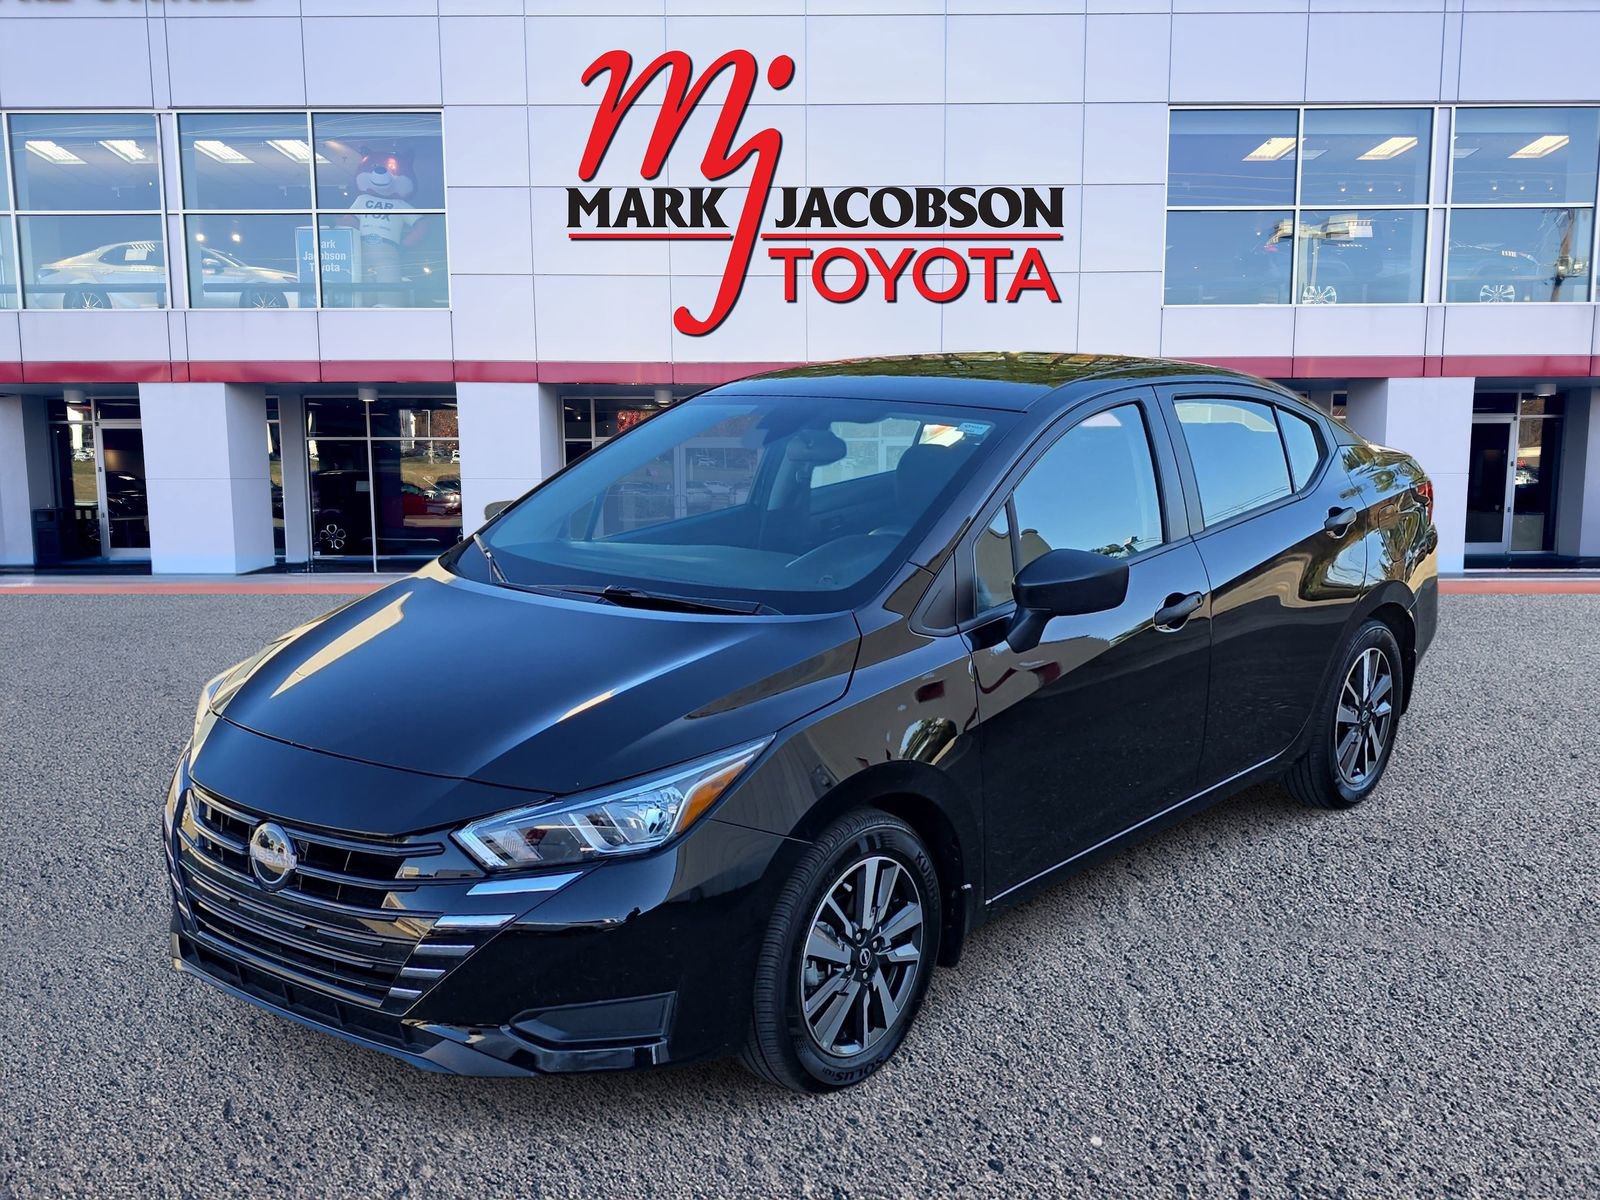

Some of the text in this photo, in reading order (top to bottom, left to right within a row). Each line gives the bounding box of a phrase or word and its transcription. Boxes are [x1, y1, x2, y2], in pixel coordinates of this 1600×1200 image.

[365, 199, 394, 209] CAR
[566, 186, 1065, 229] MARK JACOBSON
[309, 262, 340, 273] Tyota
[767, 247, 1062, 304] TOYOTA
